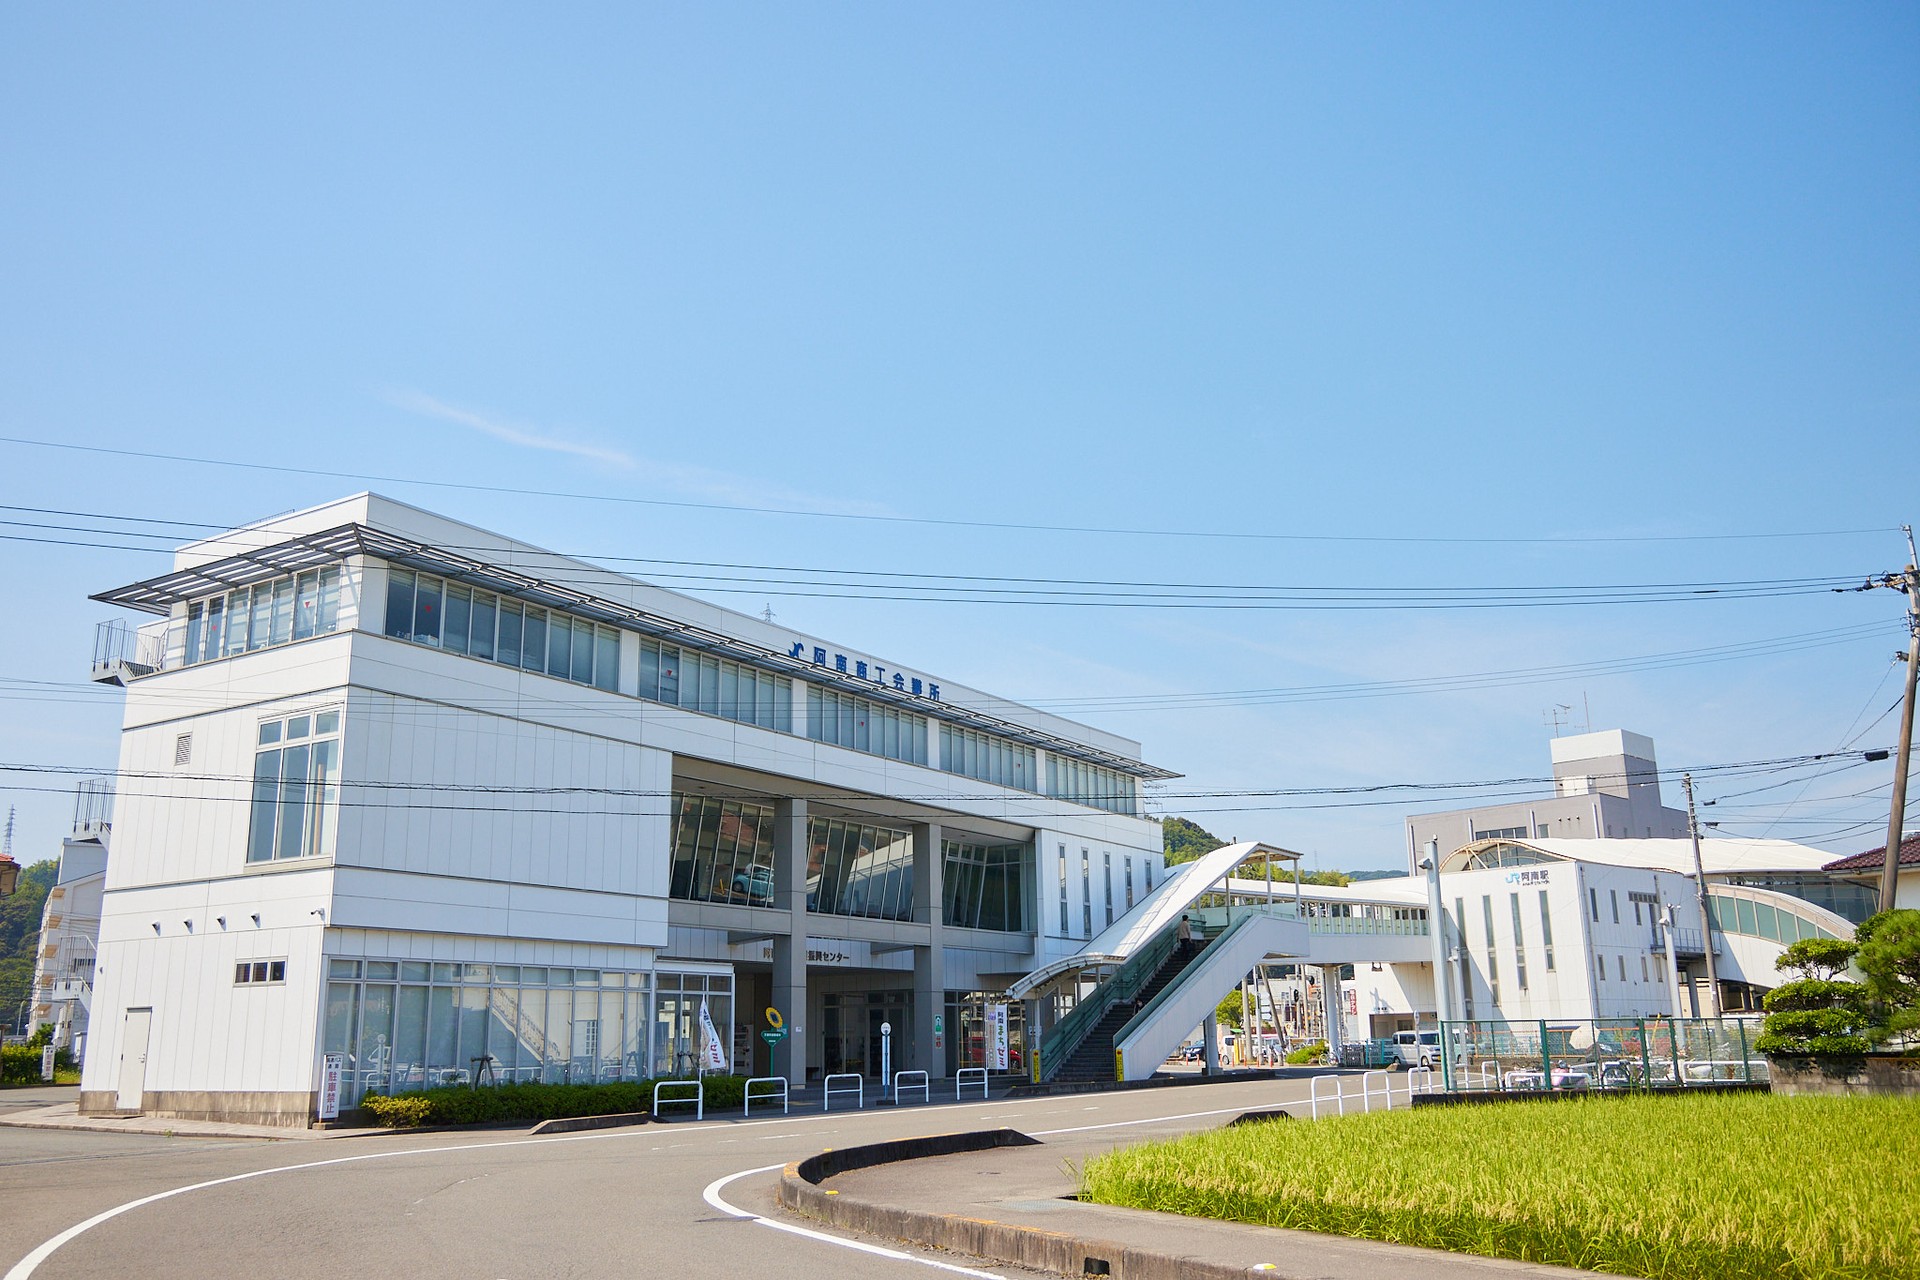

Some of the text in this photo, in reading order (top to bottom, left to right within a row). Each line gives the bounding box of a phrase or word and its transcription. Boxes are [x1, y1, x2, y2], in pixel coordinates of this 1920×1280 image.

[814, 646, 940, 701] 阿南商工会議所
[1521, 869, 1549, 881] 阿南駅
[325, 1071, 338, 1114] 駐車禁止
